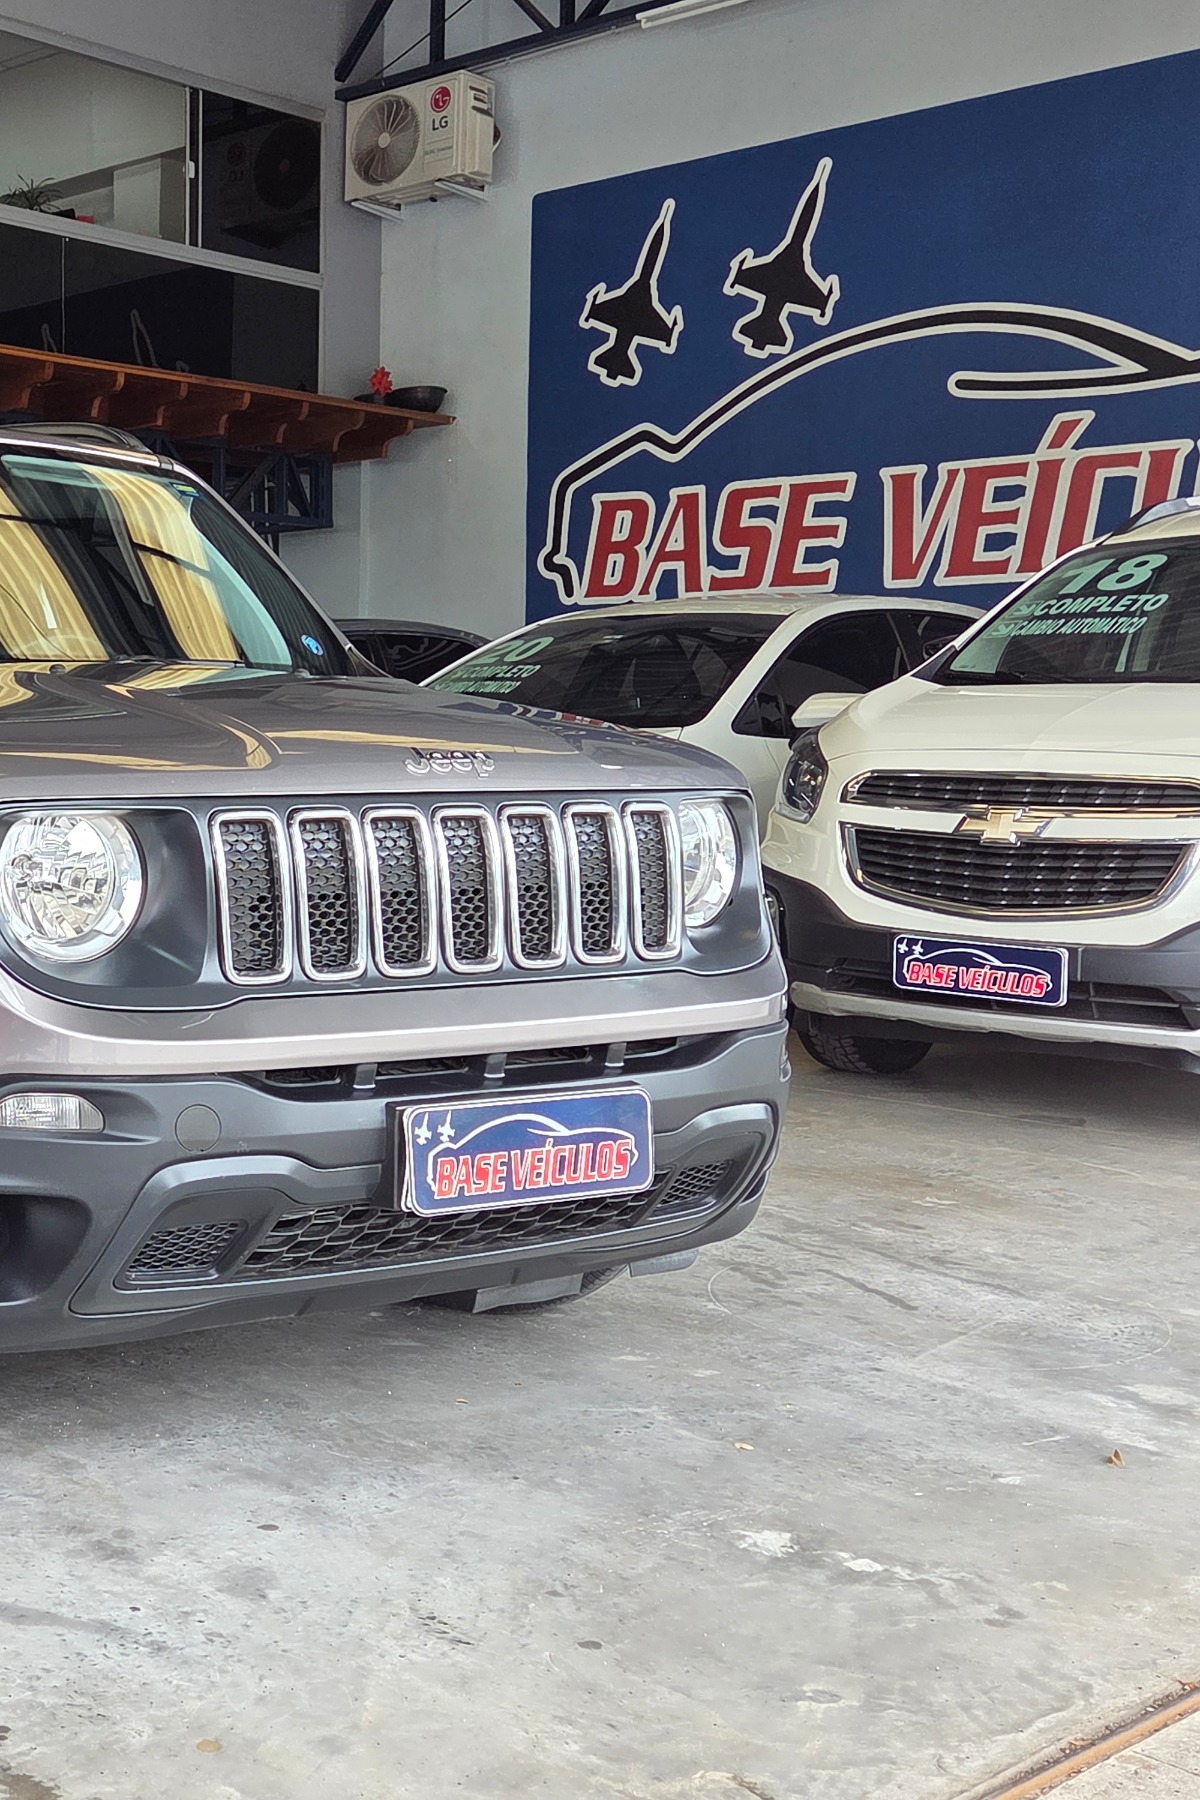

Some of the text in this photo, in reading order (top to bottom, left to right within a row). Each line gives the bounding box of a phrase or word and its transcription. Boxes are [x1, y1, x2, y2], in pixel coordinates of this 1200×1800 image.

[432, 115, 449, 131] LG
[584, 472, 857, 599] BASE
[1058, 553, 1168, 595] 18
[1032, 593, 1169, 617] COMPLETO
[1012, 618, 1065, 637] CAMBIO
[466, 636, 555, 665] 20
[404, 747, 495, 779] Jeep
[907, 961, 1048, 998] BASE VEÍCULOS
[434, 1137, 633, 1199] BASE VEÍCULOS
